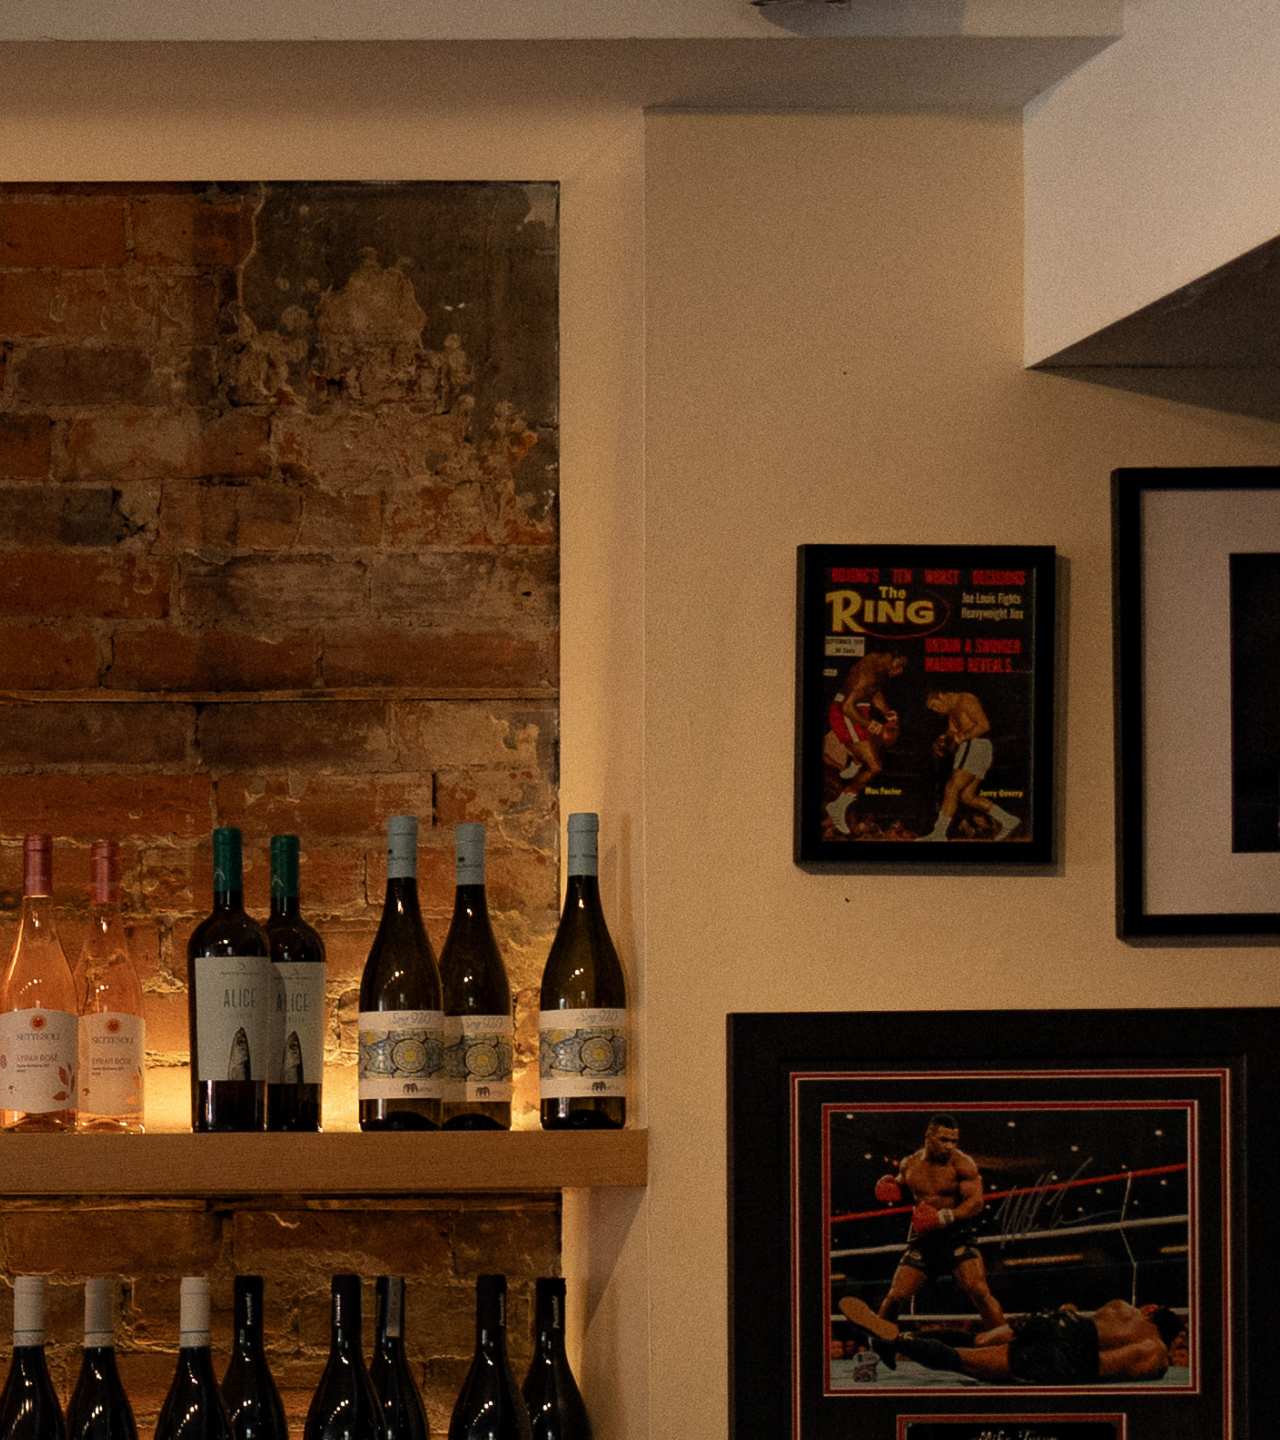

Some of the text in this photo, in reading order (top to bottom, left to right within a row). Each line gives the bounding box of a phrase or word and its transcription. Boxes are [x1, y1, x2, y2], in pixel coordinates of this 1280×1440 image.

[878, 585, 906, 599] The
[825, 590, 935, 633] RING
[224, 988, 257, 1008] ALICE
[277, 993, 311, 1012] ALICE
